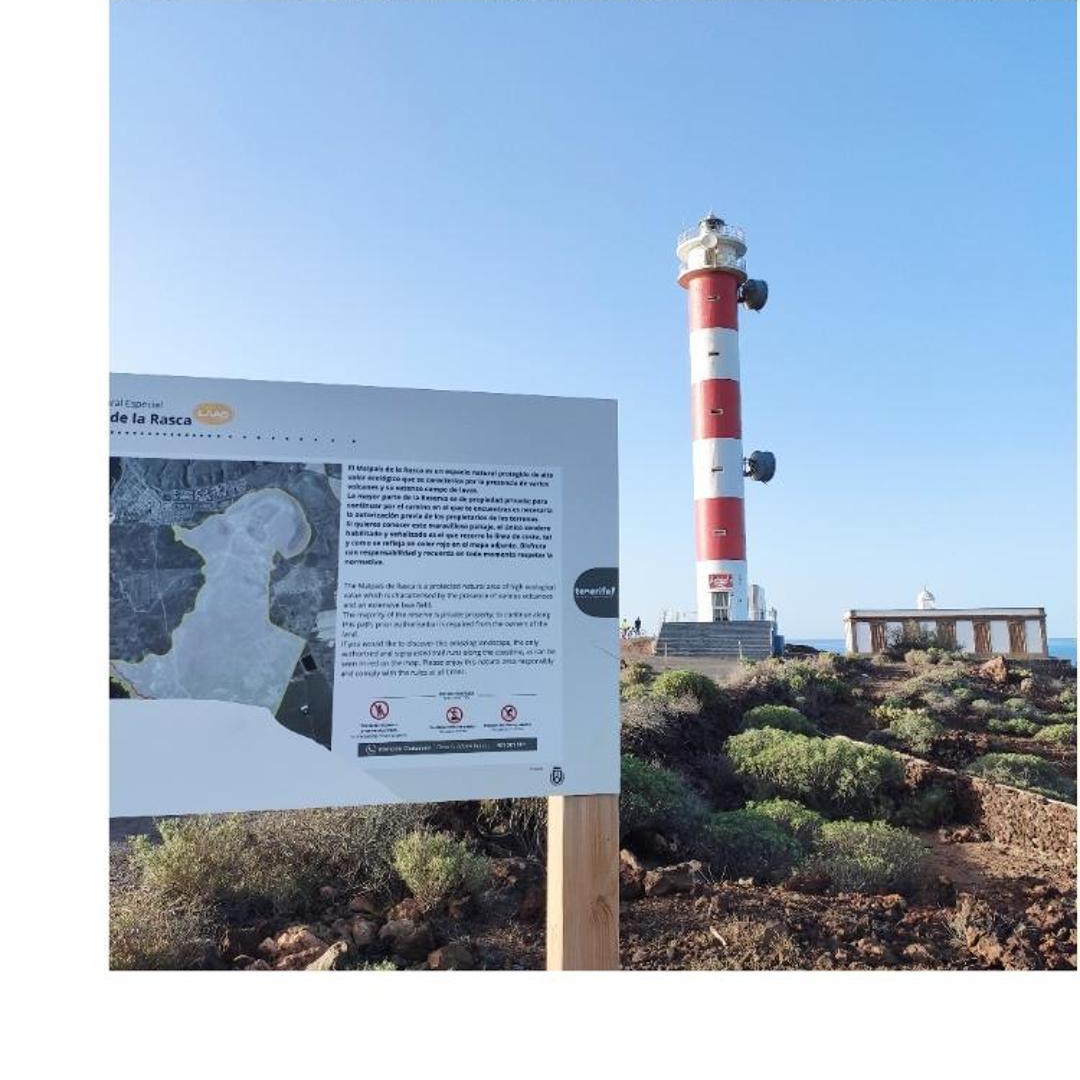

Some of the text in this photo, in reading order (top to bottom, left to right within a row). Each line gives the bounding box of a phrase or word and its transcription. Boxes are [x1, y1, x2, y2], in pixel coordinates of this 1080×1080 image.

[110, 411, 192, 425] de la Rasca
